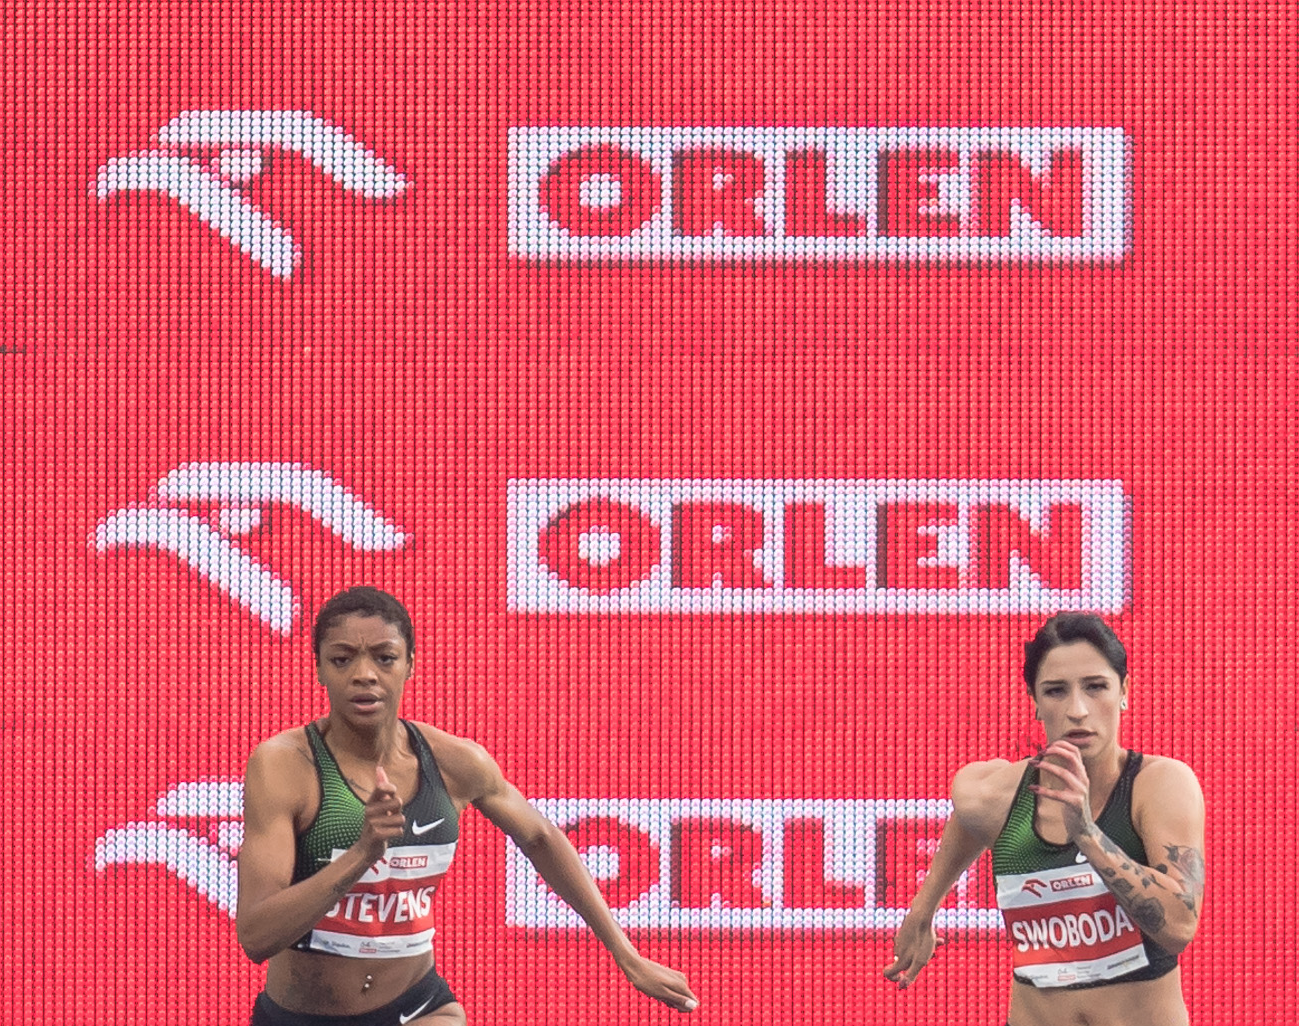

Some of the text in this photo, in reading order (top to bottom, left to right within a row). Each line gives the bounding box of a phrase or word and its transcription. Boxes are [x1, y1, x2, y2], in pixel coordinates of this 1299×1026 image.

[538, 142, 1083, 238] ORLEN
[538, 497, 1083, 592] ORLEN
[390, 857, 426, 867] ORLEN
[540, 816, 996, 909] ORLE
[1052, 876, 1092, 890] ORLEN
[1012, 906, 1134, 952] SWOBODA
